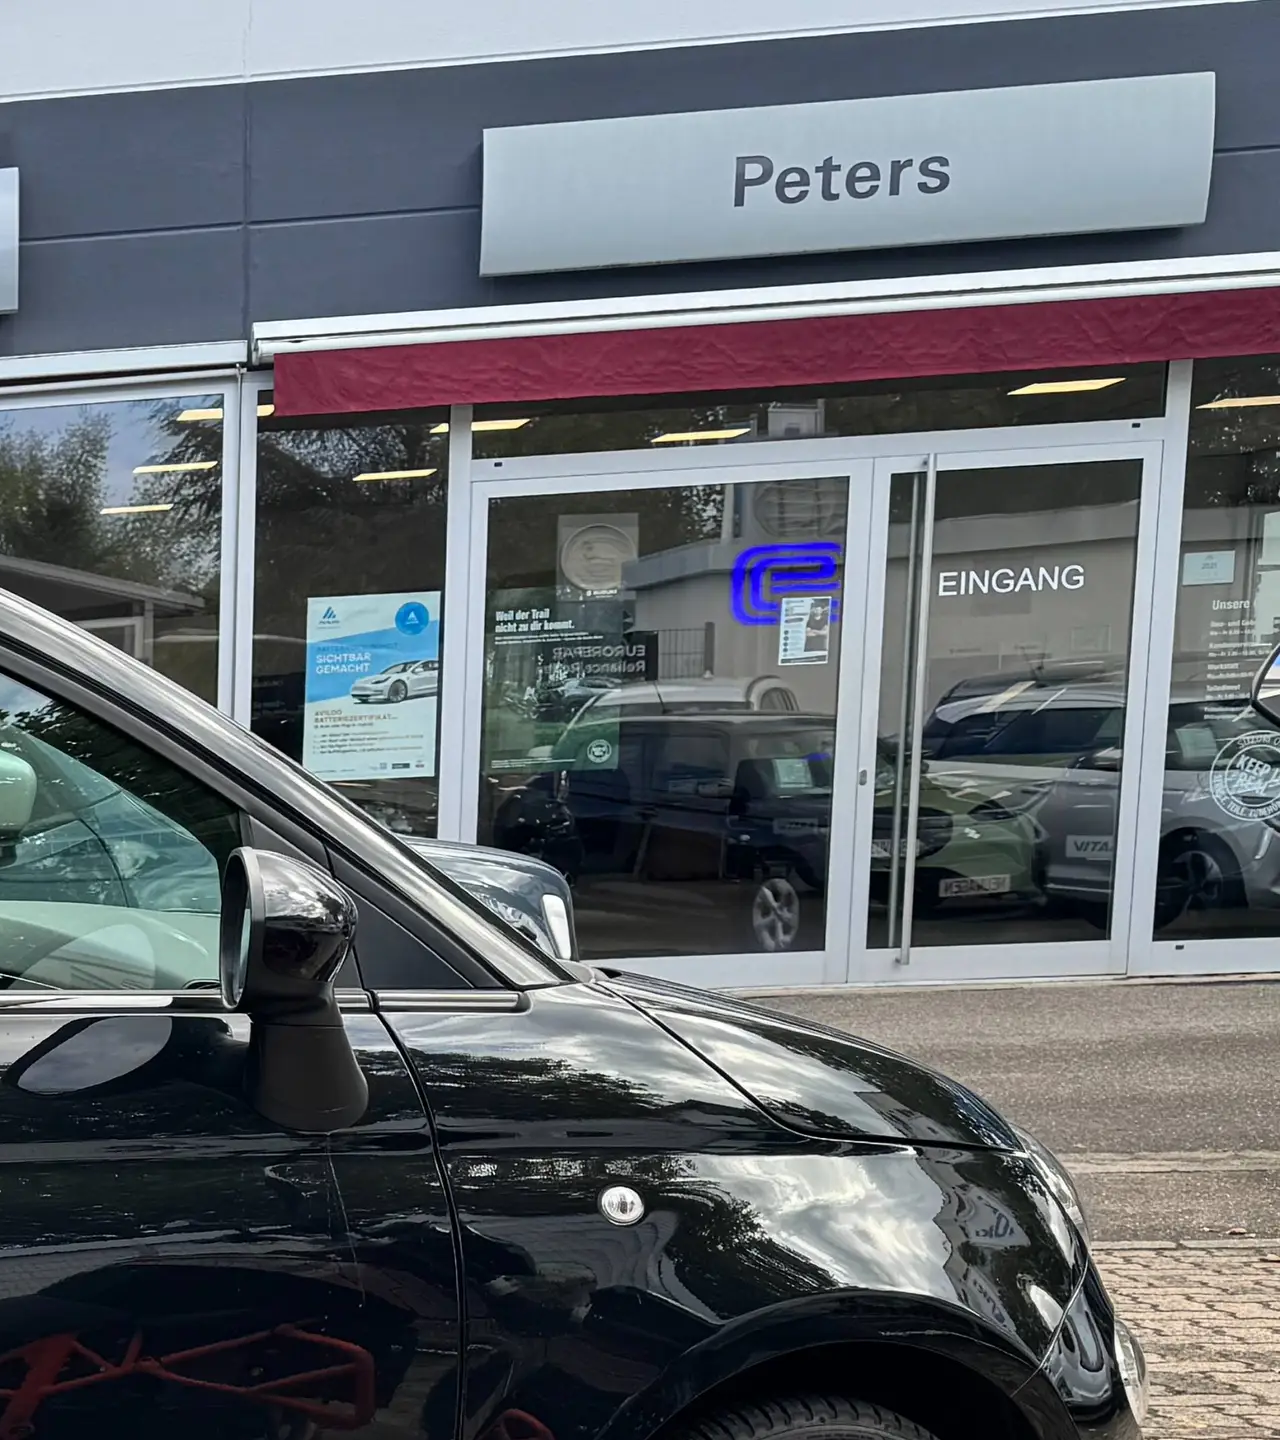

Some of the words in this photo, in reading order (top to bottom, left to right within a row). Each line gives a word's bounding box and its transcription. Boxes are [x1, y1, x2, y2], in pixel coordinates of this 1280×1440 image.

[733, 154, 951, 208] Peters
[938, 564, 1085, 597] EINGANG
[1212, 599, 1251, 610] Unsere
[495, 610, 514, 621] Weil
[515, 609, 530, 620] der
[531, 608, 550, 619] Trail
[495, 622, 517, 633] nicht
[518, 623, 529, 631] zu
[530, 621, 542, 631] dir
[316, 652, 372, 663] SICHTBAR
[316, 663, 371, 675] GEMACHT
[1236, 754, 1272, 777] KEEP
[1072, 839, 1112, 853] VITA
